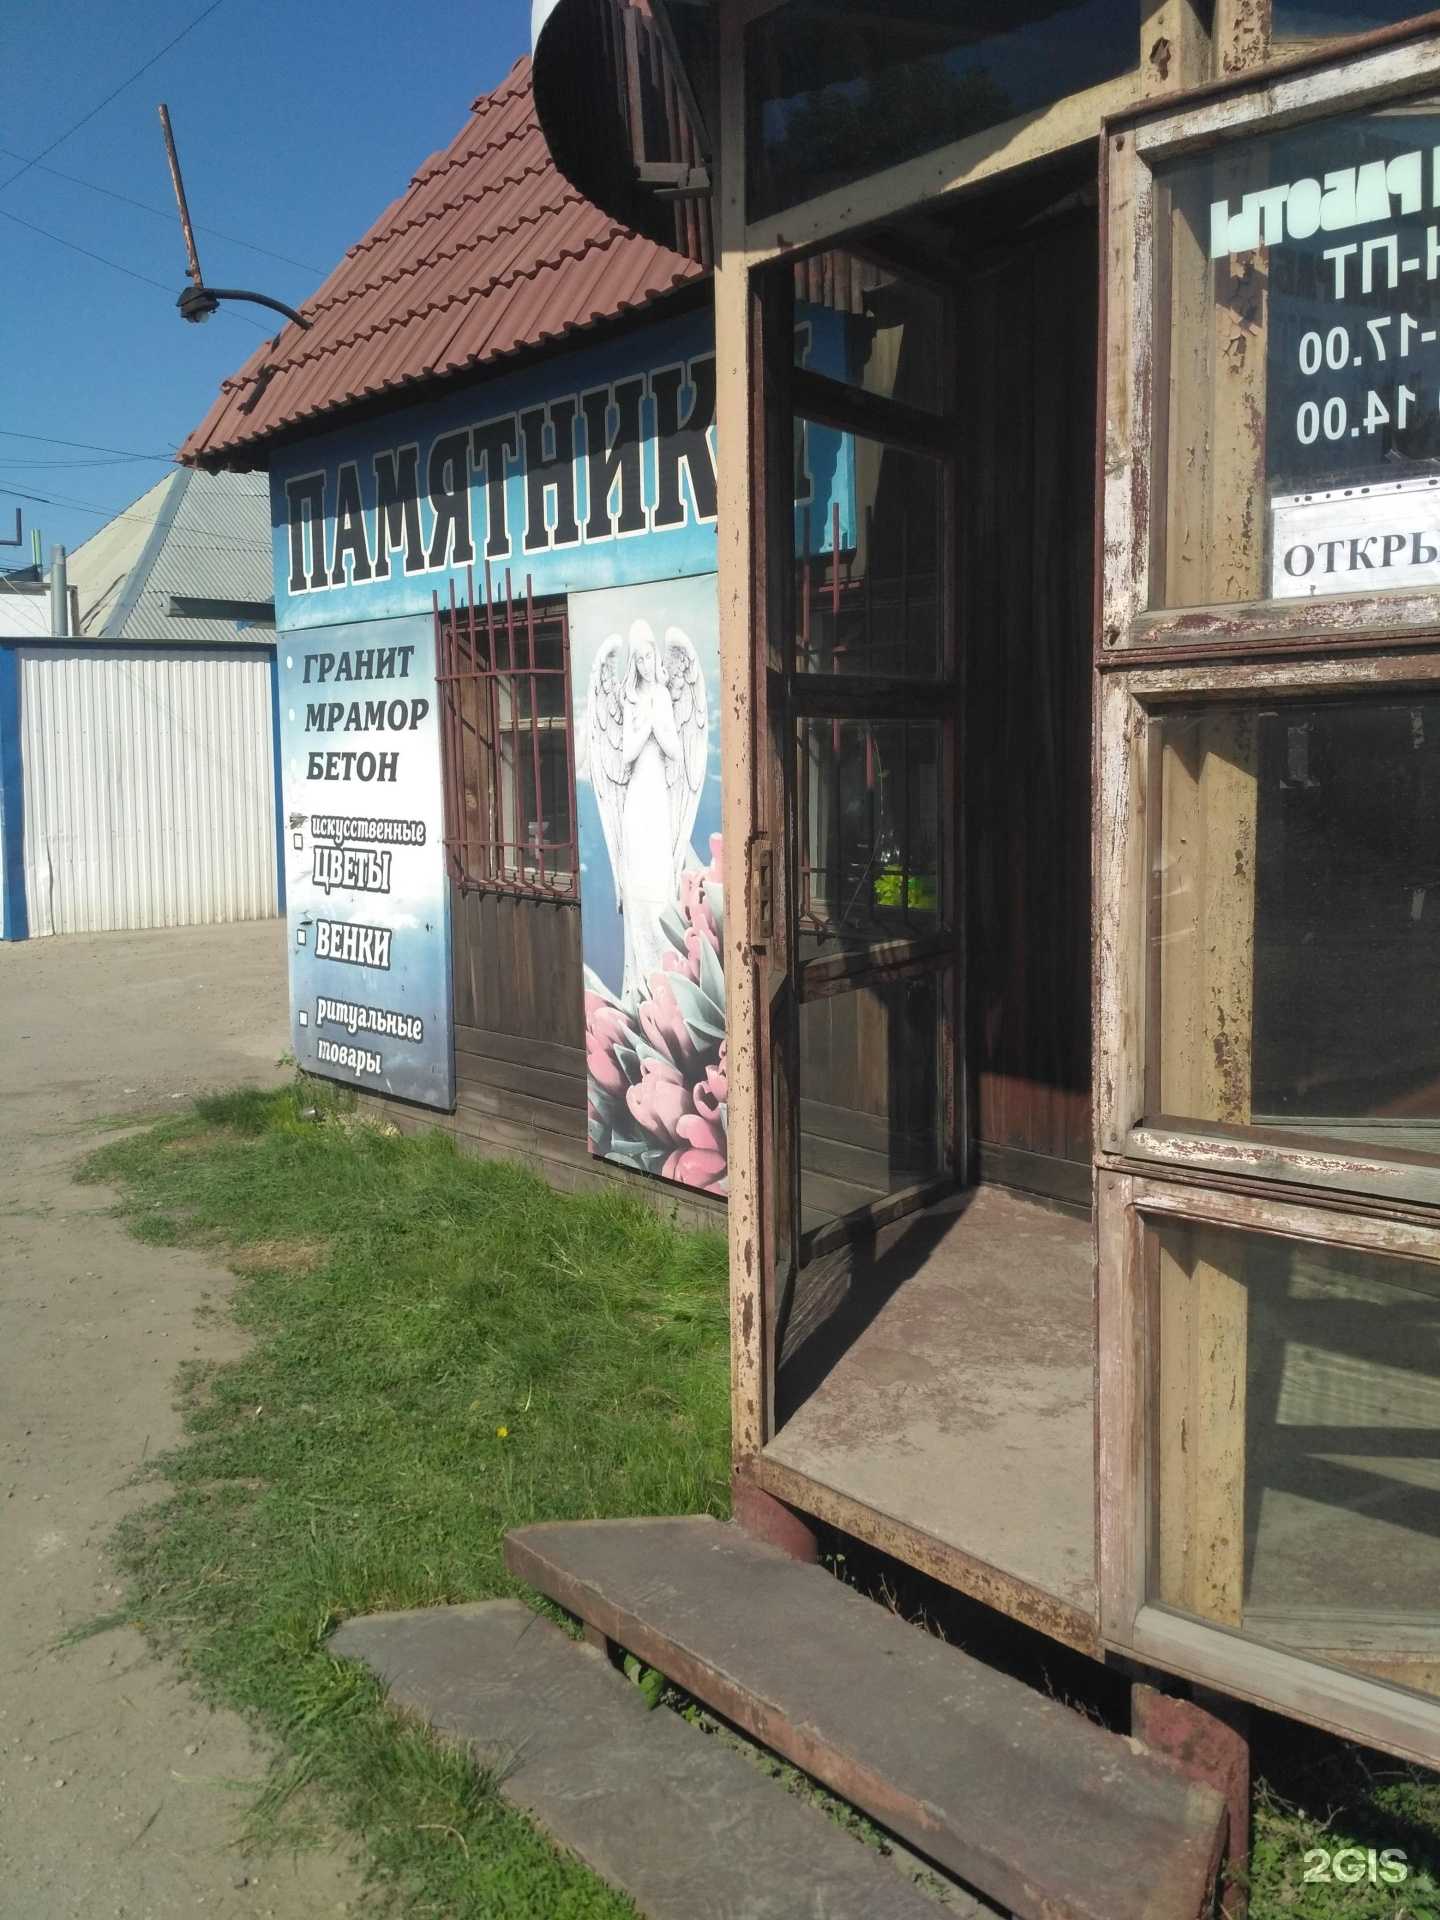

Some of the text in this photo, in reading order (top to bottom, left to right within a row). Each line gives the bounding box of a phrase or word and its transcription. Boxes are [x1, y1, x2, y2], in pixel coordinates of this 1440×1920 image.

[284, 321, 813, 596] ПАМЯТНИК
[302, 645, 415, 684] ГРАНИТ
[304, 698, 429, 732] МРАМОР
[306, 752, 400, 782] БЕТОН
[311, 815, 426, 846] искусственные
[312, 845, 391, 895] ЦВЕТЫ
[315, 918, 392, 971] ВЕНКИ
[316, 996, 423, 1043] ритуальные
[317, 1039, 382, 1078] товары
